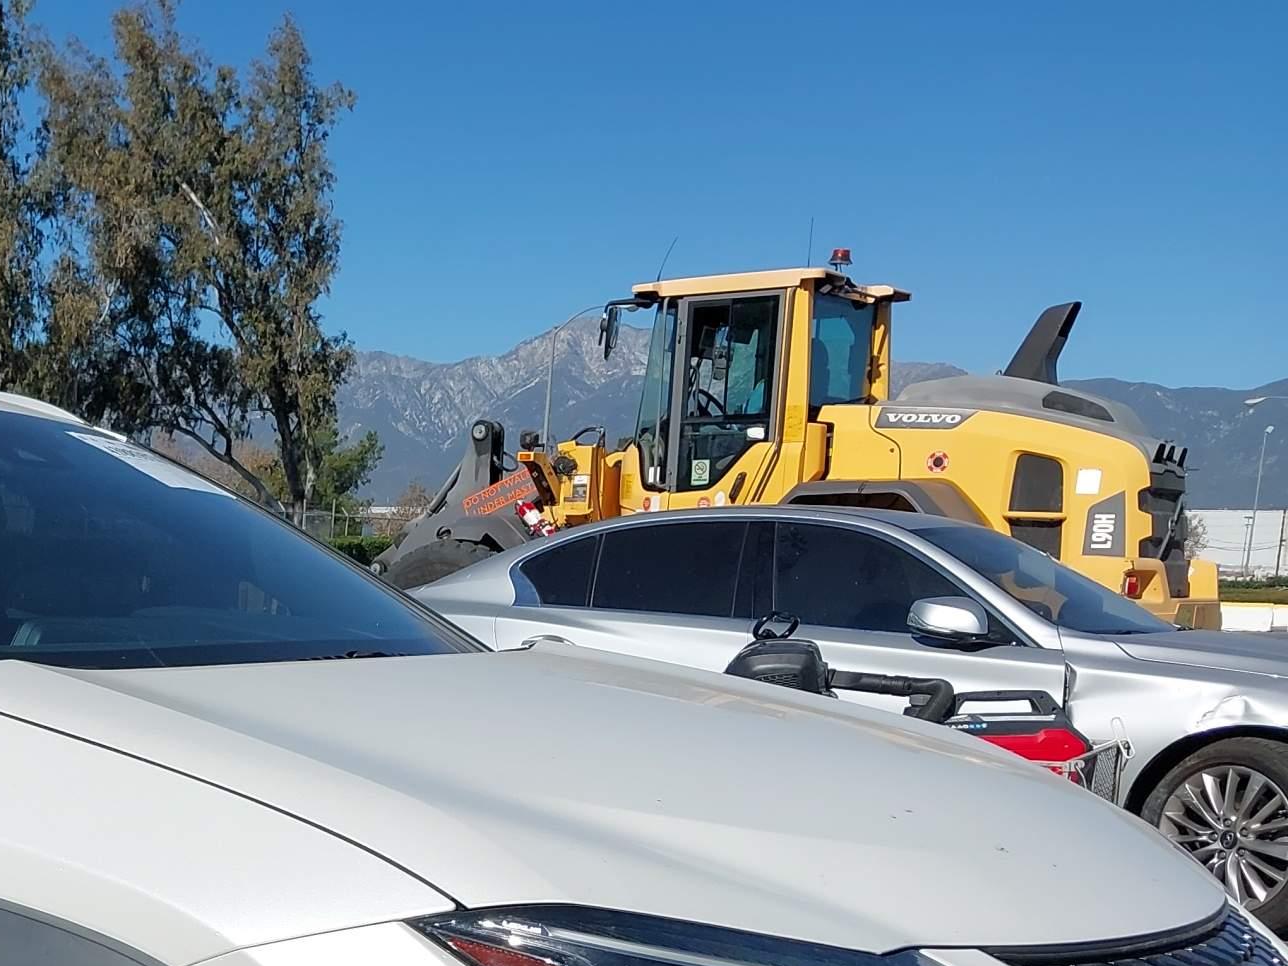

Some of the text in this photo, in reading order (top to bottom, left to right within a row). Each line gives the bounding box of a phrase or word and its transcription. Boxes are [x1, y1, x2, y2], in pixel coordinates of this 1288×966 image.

[886, 413, 962, 424] VOLVO
[463, 496, 479, 509] DO
[481, 485, 501, 500] NOT
[508, 483, 533, 501] MAST
[1090, 513, 1116, 549] L90H
